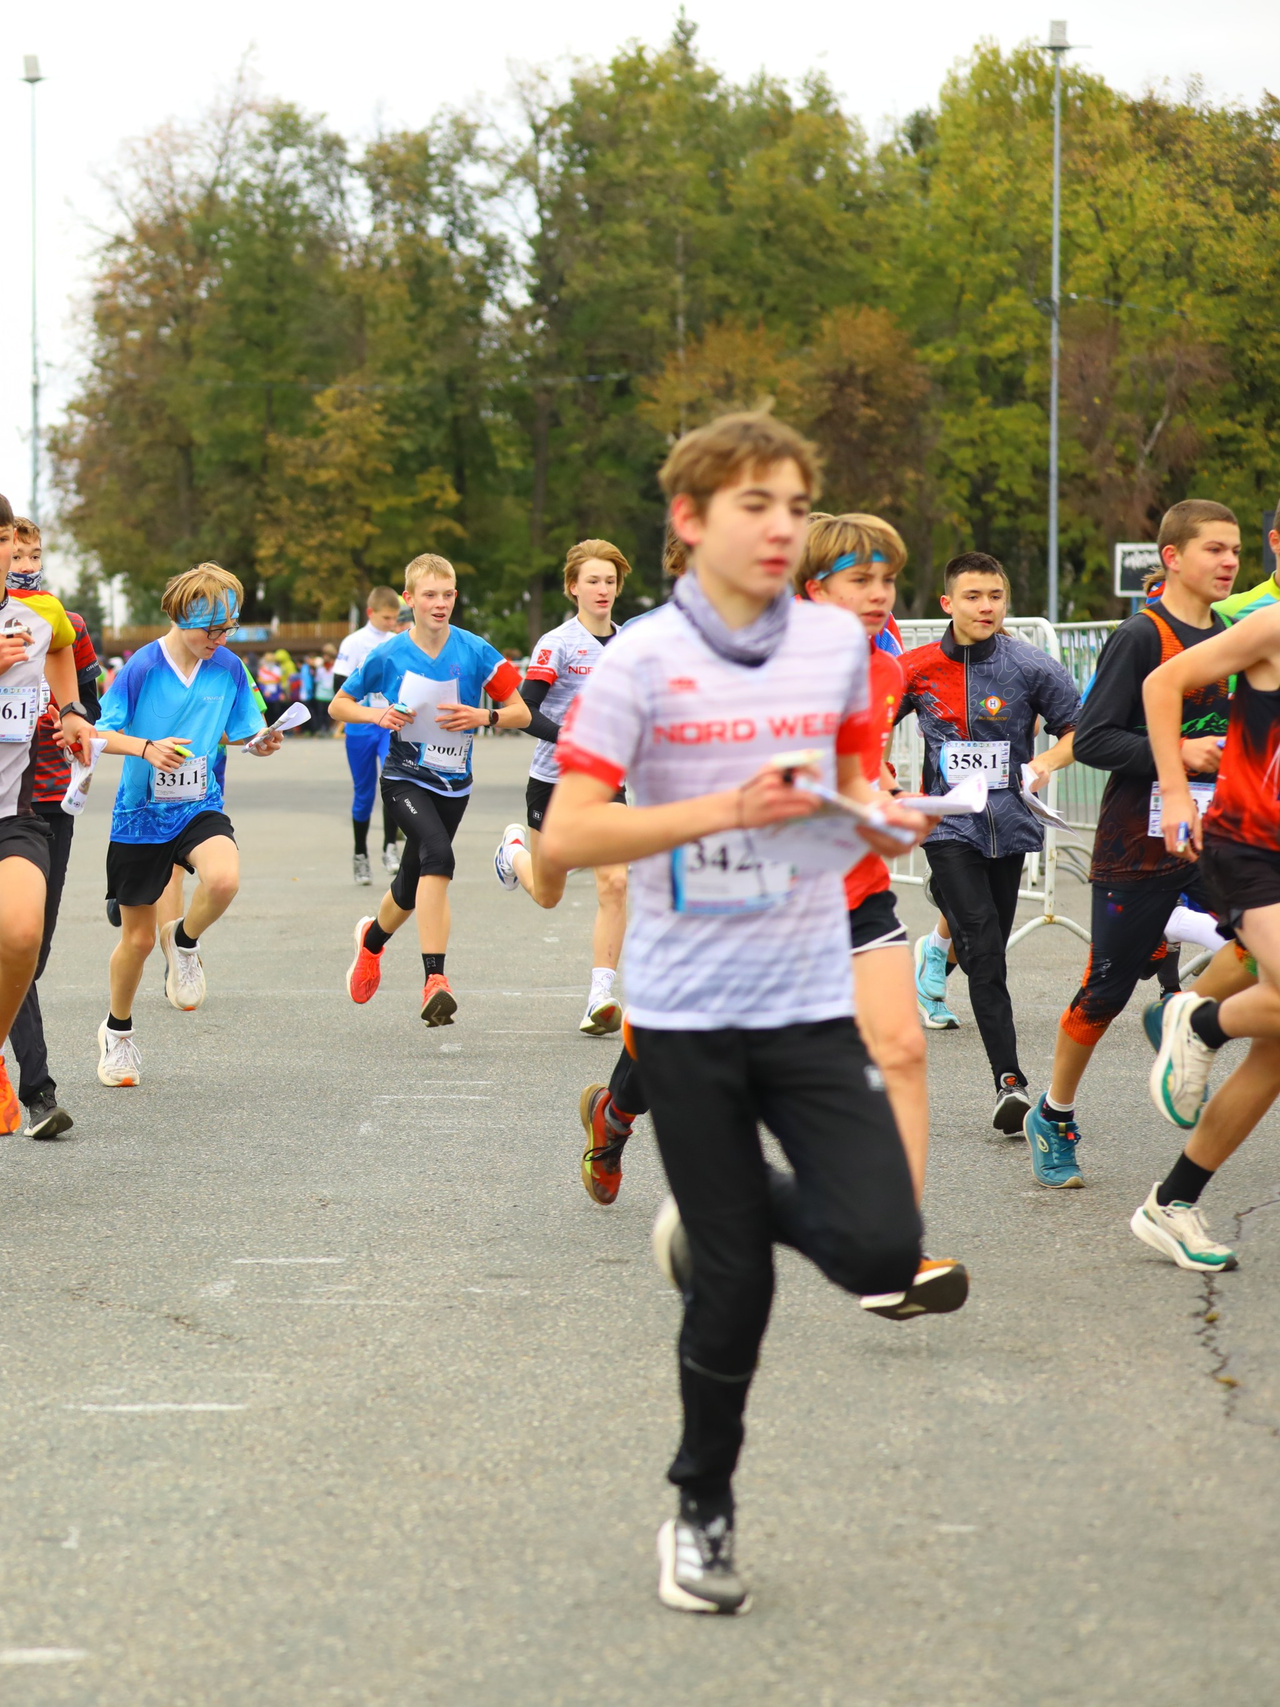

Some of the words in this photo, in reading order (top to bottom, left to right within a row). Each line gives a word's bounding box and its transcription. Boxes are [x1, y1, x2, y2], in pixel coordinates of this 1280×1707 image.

[653, 718, 756, 746] NORD
[768, 712, 842, 740] WES
[948, 753, 998, 770] 358.1
[156, 770, 199, 787] 331.1
